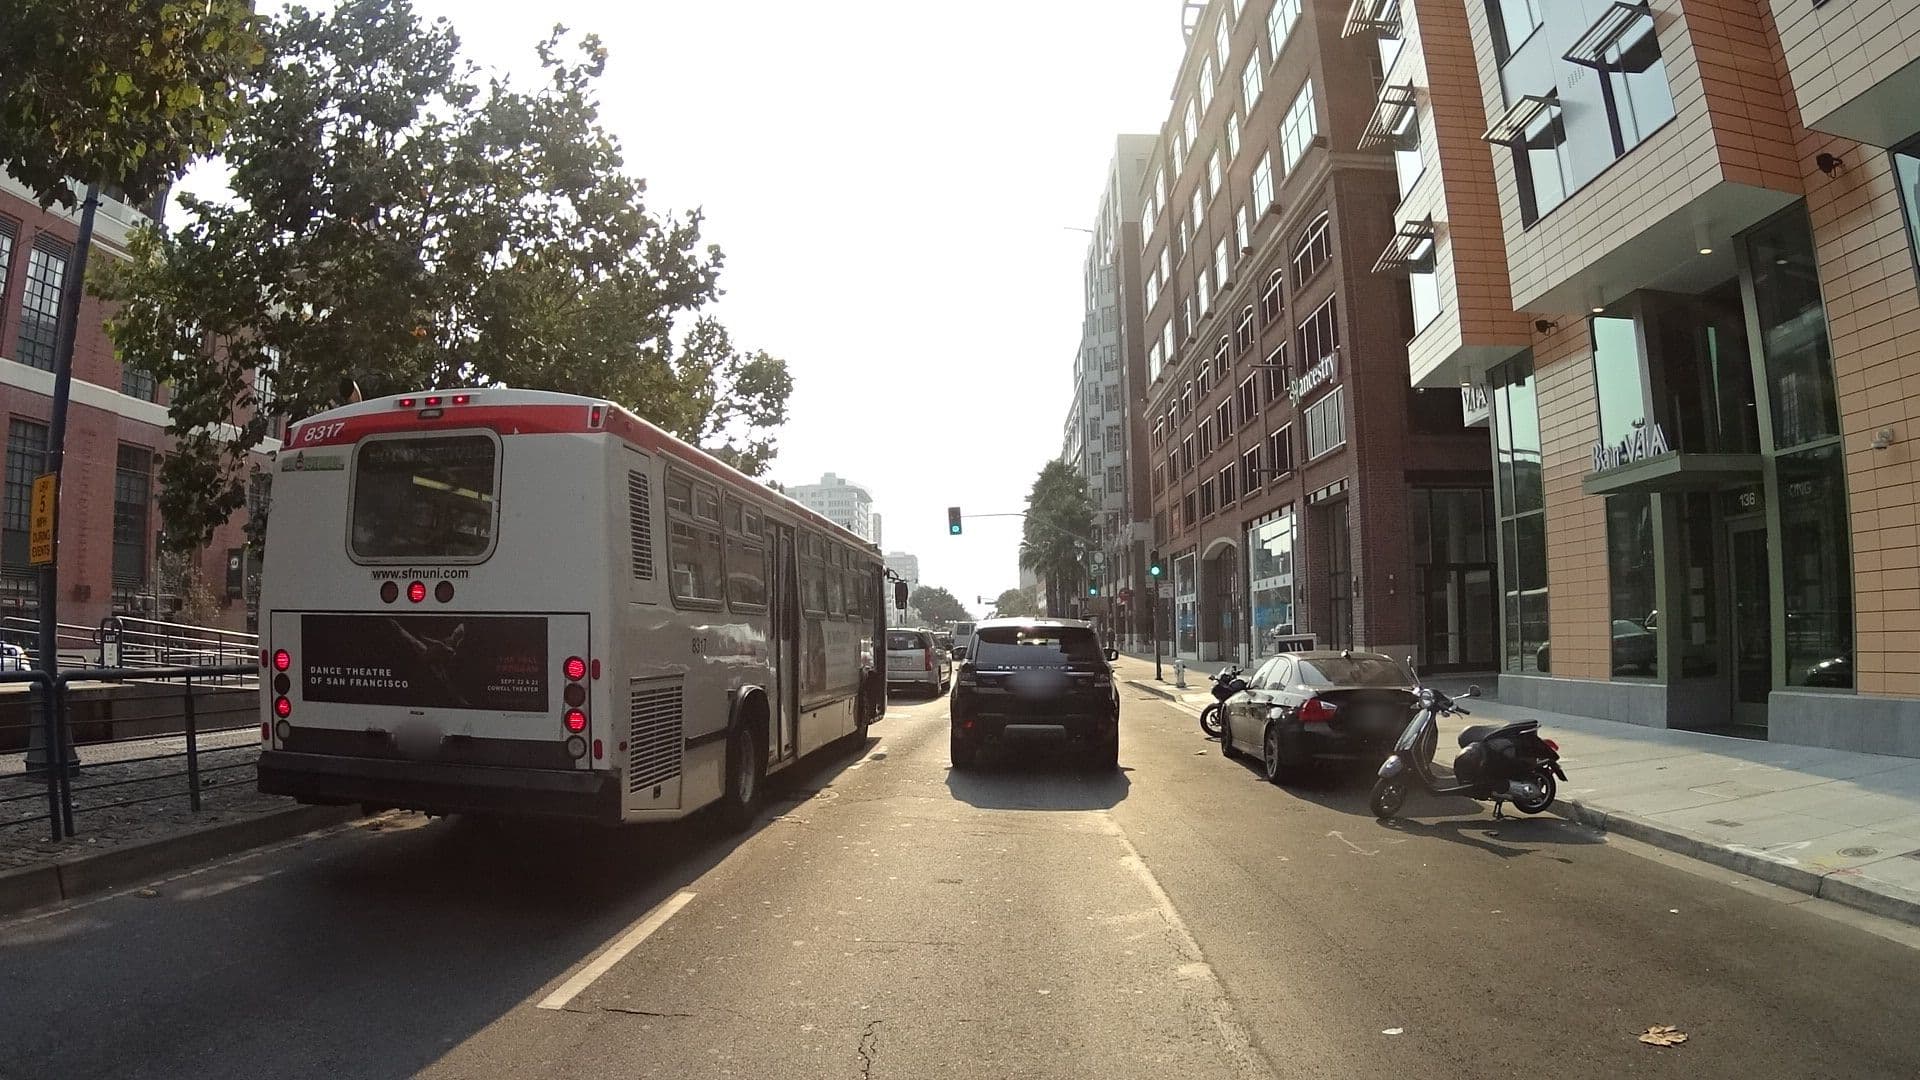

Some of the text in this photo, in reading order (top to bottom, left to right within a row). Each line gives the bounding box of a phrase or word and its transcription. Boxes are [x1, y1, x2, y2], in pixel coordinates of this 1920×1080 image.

[1299, 353, 1334, 397] ancestry
[303, 422, 345, 442] 8317
[1593, 443, 1620, 472] Bar
[32, 544, 50, 558] EVENTS
[372, 567, 469, 579] www.sfmuni.com
[692, 637, 707, 655] 8317
[310, 666, 392, 677] DANCE THEATRE
[310, 677, 409, 688] OF SAN FRANCISCO
